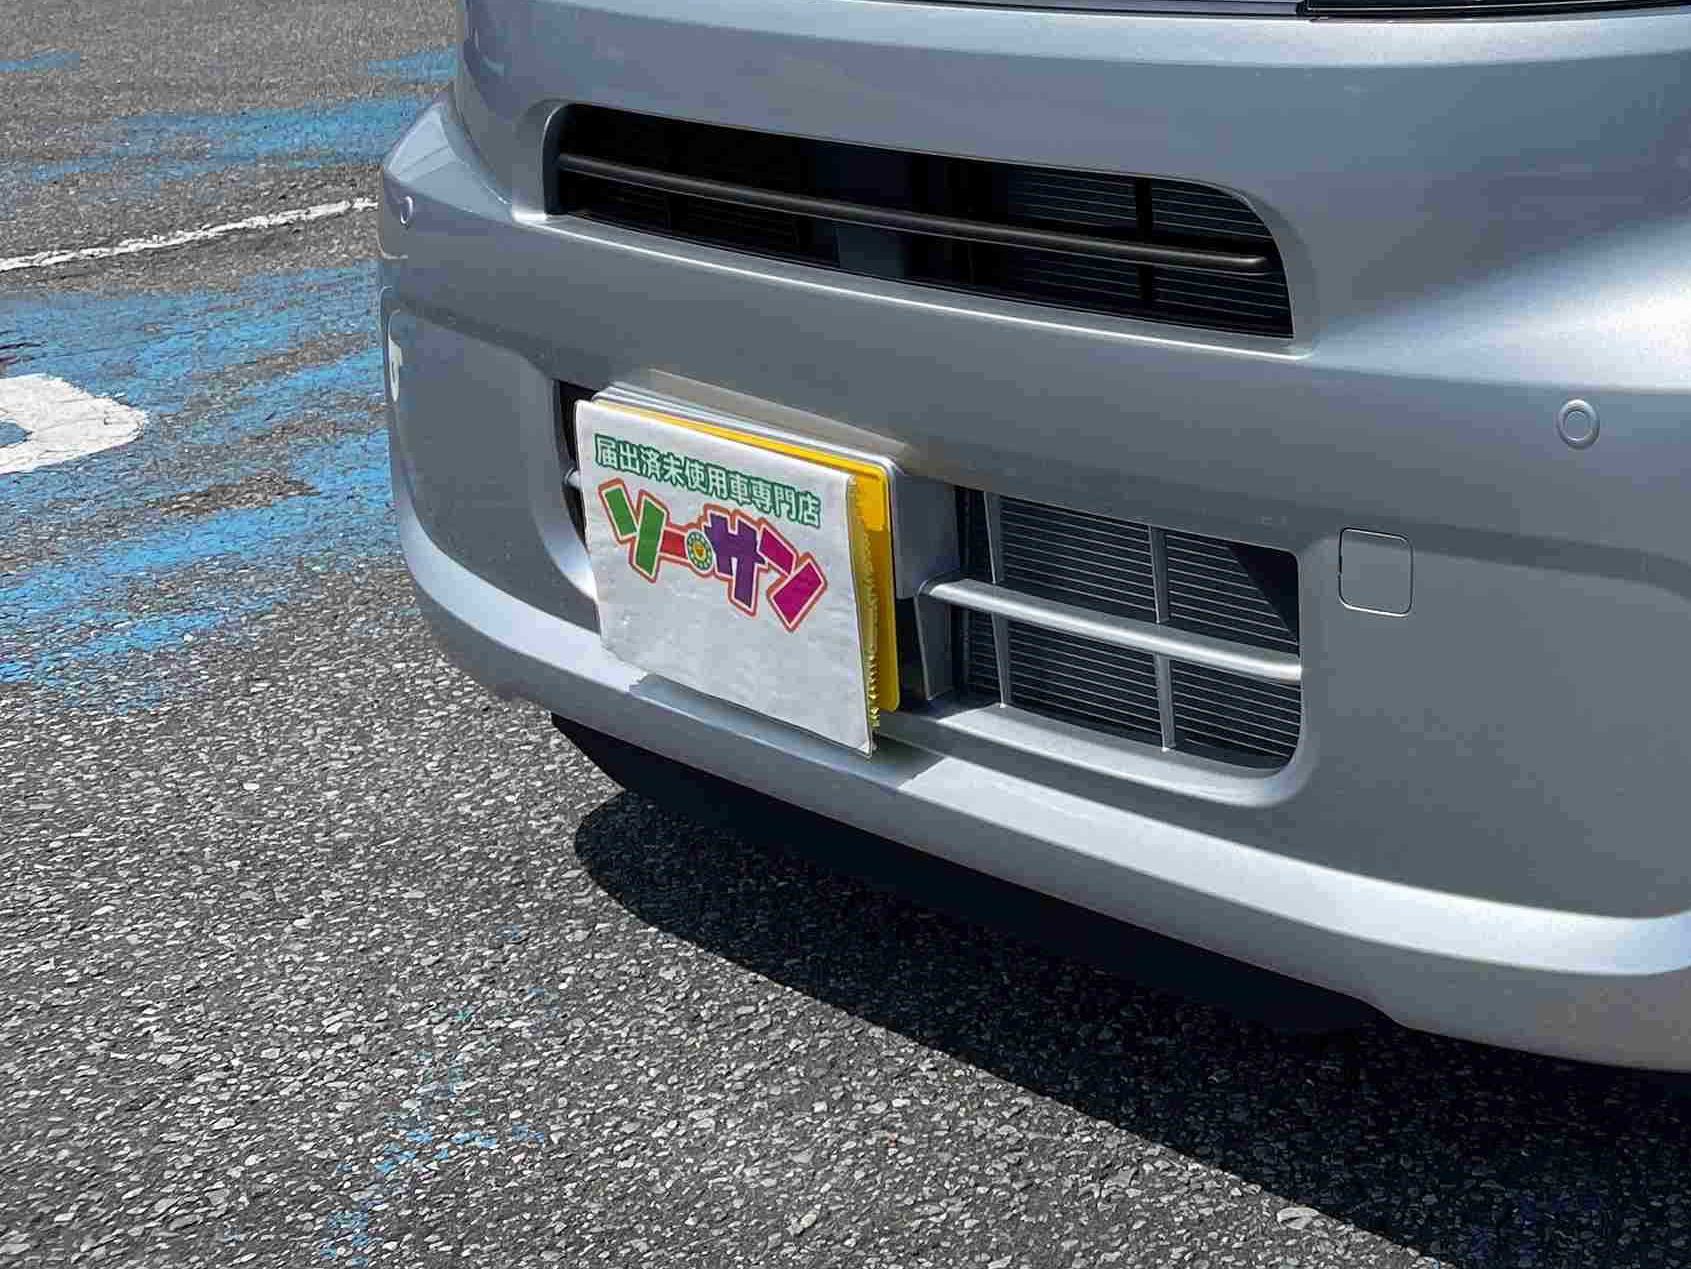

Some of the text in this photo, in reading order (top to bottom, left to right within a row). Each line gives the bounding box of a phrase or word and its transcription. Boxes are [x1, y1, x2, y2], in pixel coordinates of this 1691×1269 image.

[594, 434, 822, 528] 届出済未使用車専門店
